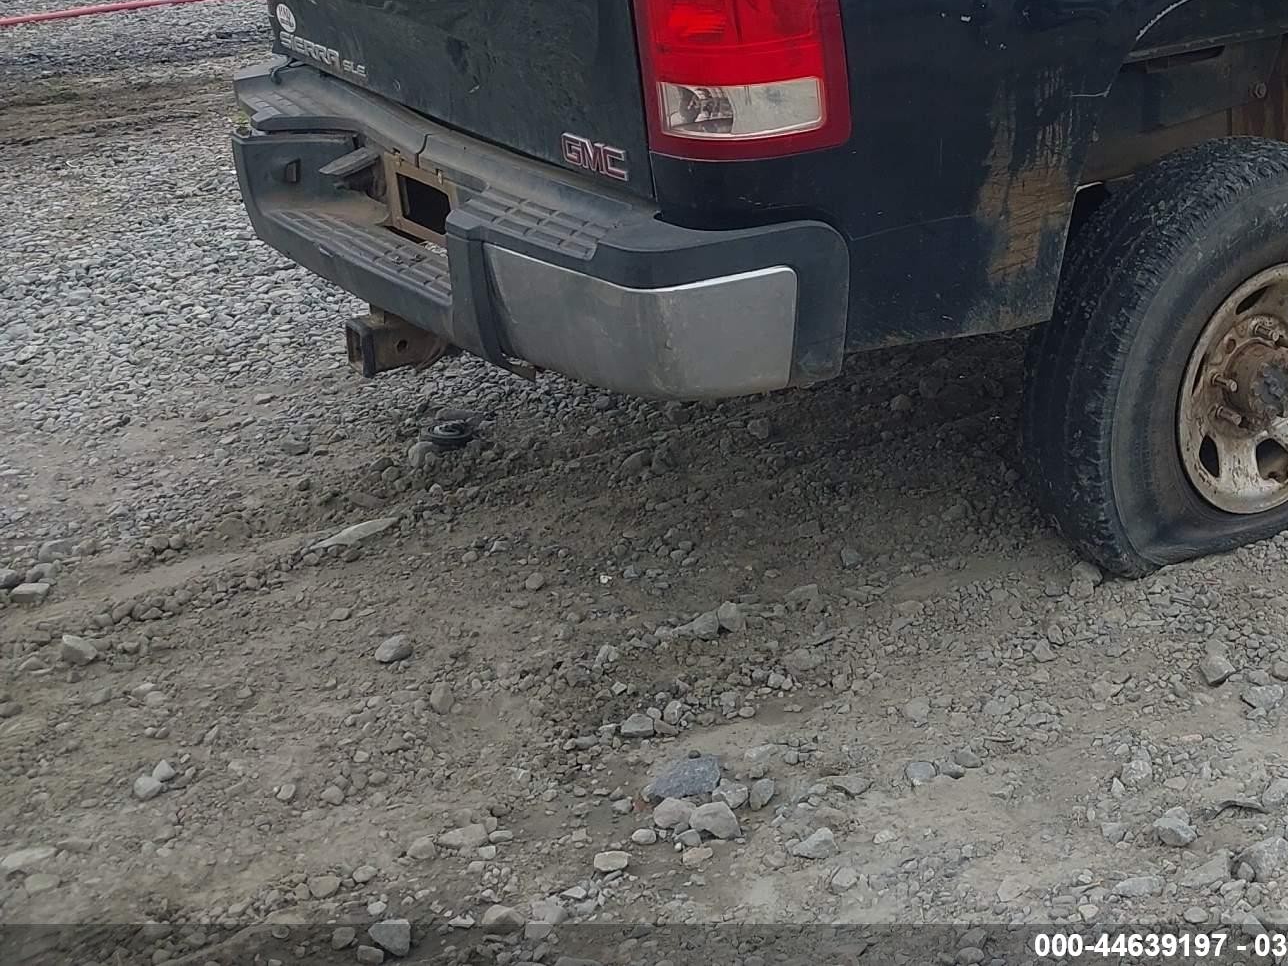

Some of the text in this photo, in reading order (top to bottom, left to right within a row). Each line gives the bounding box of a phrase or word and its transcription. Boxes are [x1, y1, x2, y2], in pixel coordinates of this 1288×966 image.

[279, 30, 367, 77] SIERRA SLE
[561, 132, 629, 182] GMC
